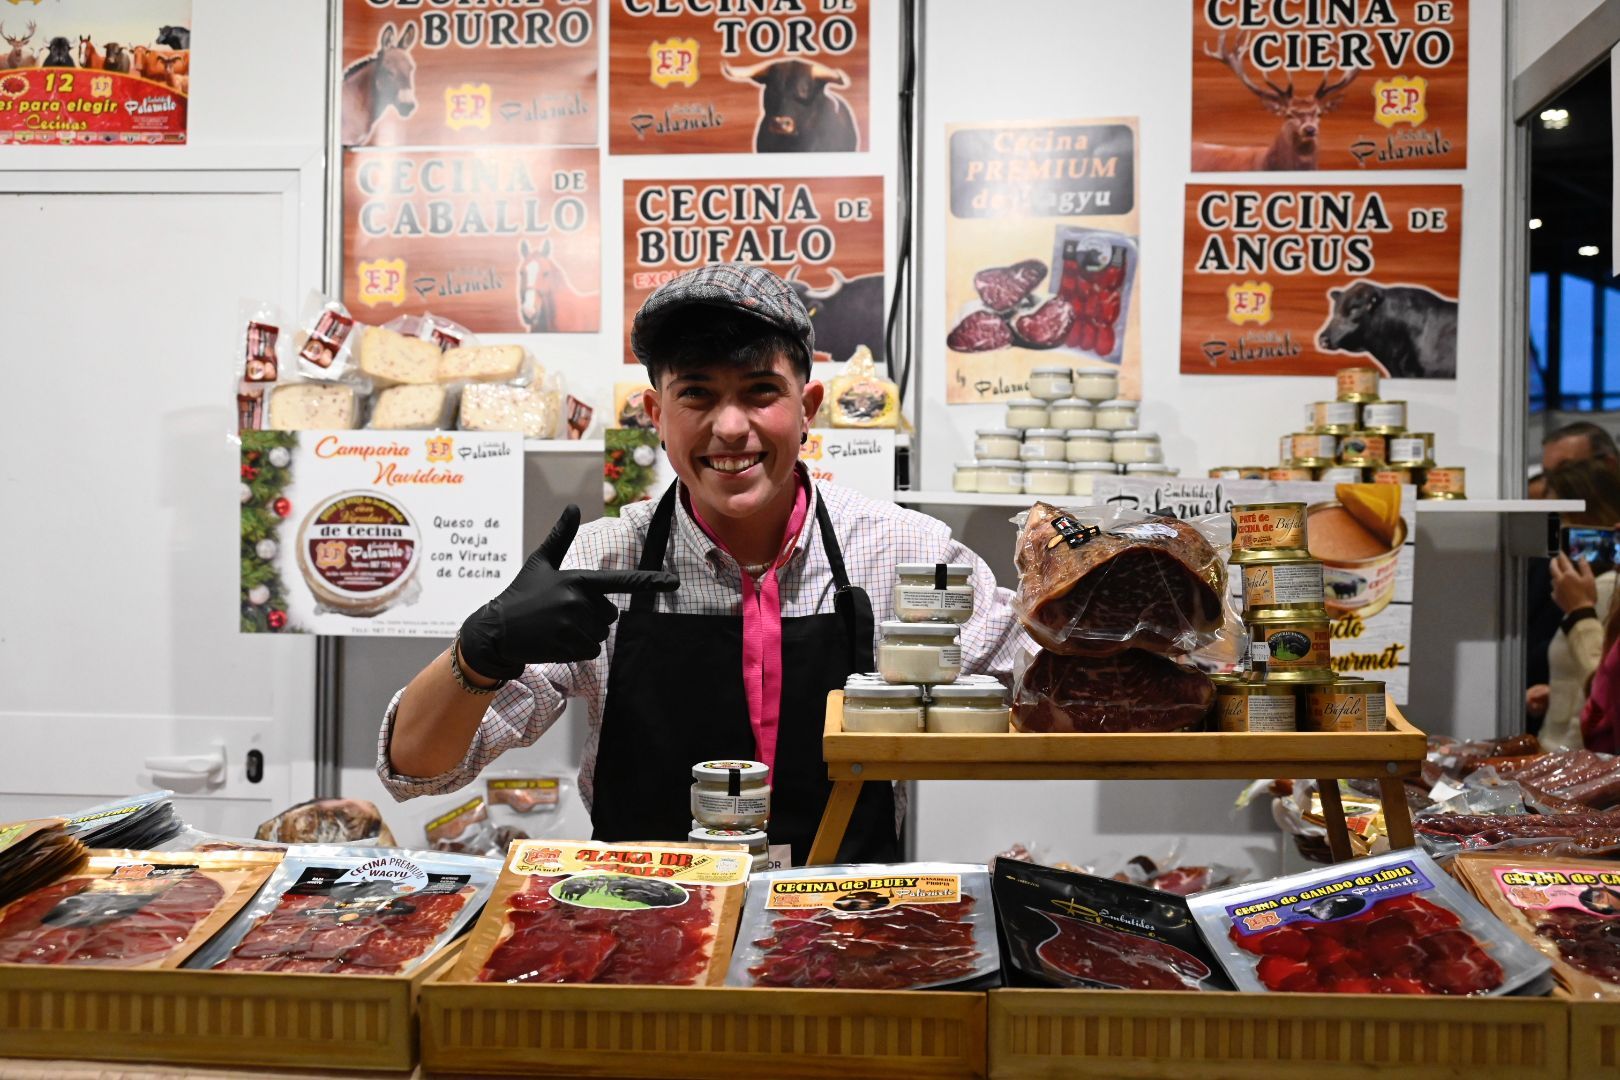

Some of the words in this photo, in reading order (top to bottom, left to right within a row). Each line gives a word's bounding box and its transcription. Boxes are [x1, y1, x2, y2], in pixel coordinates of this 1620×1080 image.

[1208, 0, 1396, 26] CECINA
[1417, 4, 1451, 22] DE
[423, 11, 590, 46] BURRO
[717, 18, 855, 54] TORO
[1253, 30, 1451, 68] CIERVO
[45, 73, 74, 93] 12
[19, 101, 61, 113] para
[67, 99, 118, 114] elegir
[26, 114, 88, 130] Cecinas
[630, 105, 724, 137] Palazuelo
[994, 130, 1090, 153] Cecina
[1350, 130, 1451, 166] Palazuelo
[358, 159, 536, 194] CECINA
[554, 172, 585, 190] DE
[966, 157, 1120, 181] PREMIUM
[639, 187, 818, 221] CECINA
[837, 201, 869, 219] DE
[1201, 195, 1388, 229] CECINA
[1411, 211, 1445, 230] DE
[361, 199, 586, 235] CABALLO
[640, 227, 832, 264] BUFALO
[1198, 237, 1371, 272] ANGUS
[1202, 333, 1301, 366] Palazuelo
[314, 436, 411, 460] Campaña
[371, 461, 465, 486] Navideña
[1164, 483, 1214, 499] Embutidos
[321, 526, 340, 536] de
[347, 526, 402, 536] Cecina
[433, 516, 473, 529] Queso
[485, 517, 500, 528] de
[1263, 524, 1274, 532] de
[450, 534, 488, 548] Oveja
[431, 551, 453, 562] con
[459, 550, 507, 563] Virutas
[436, 567, 452, 578] de
[458, 567, 501, 579] Cecina
[1330, 643, 1405, 671] ourmet
[1324, 697, 1360, 722] Búfalo
[350, 858, 387, 877] CECINA
[389, 857, 426, 880] PREMIUM
[660, 852, 694, 866] DE
[369, 869, 408, 879] WAGYU
[775, 882, 837, 893] CECINA
[840, 881, 864, 891] de
[869, 878, 917, 888] BUEY
[1571, 873, 1598, 884] de
[1234, 900, 1278, 917] CECINA
[1280, 895, 1298, 905] de
[1300, 880, 1353, 900] GANADO
[1356, 875, 1372, 886] de
[1373, 865, 1414, 883] LÍDIA
[1351, 877, 1419, 896] Palazuelo
[1099, 908, 1156, 931] Embutidos
